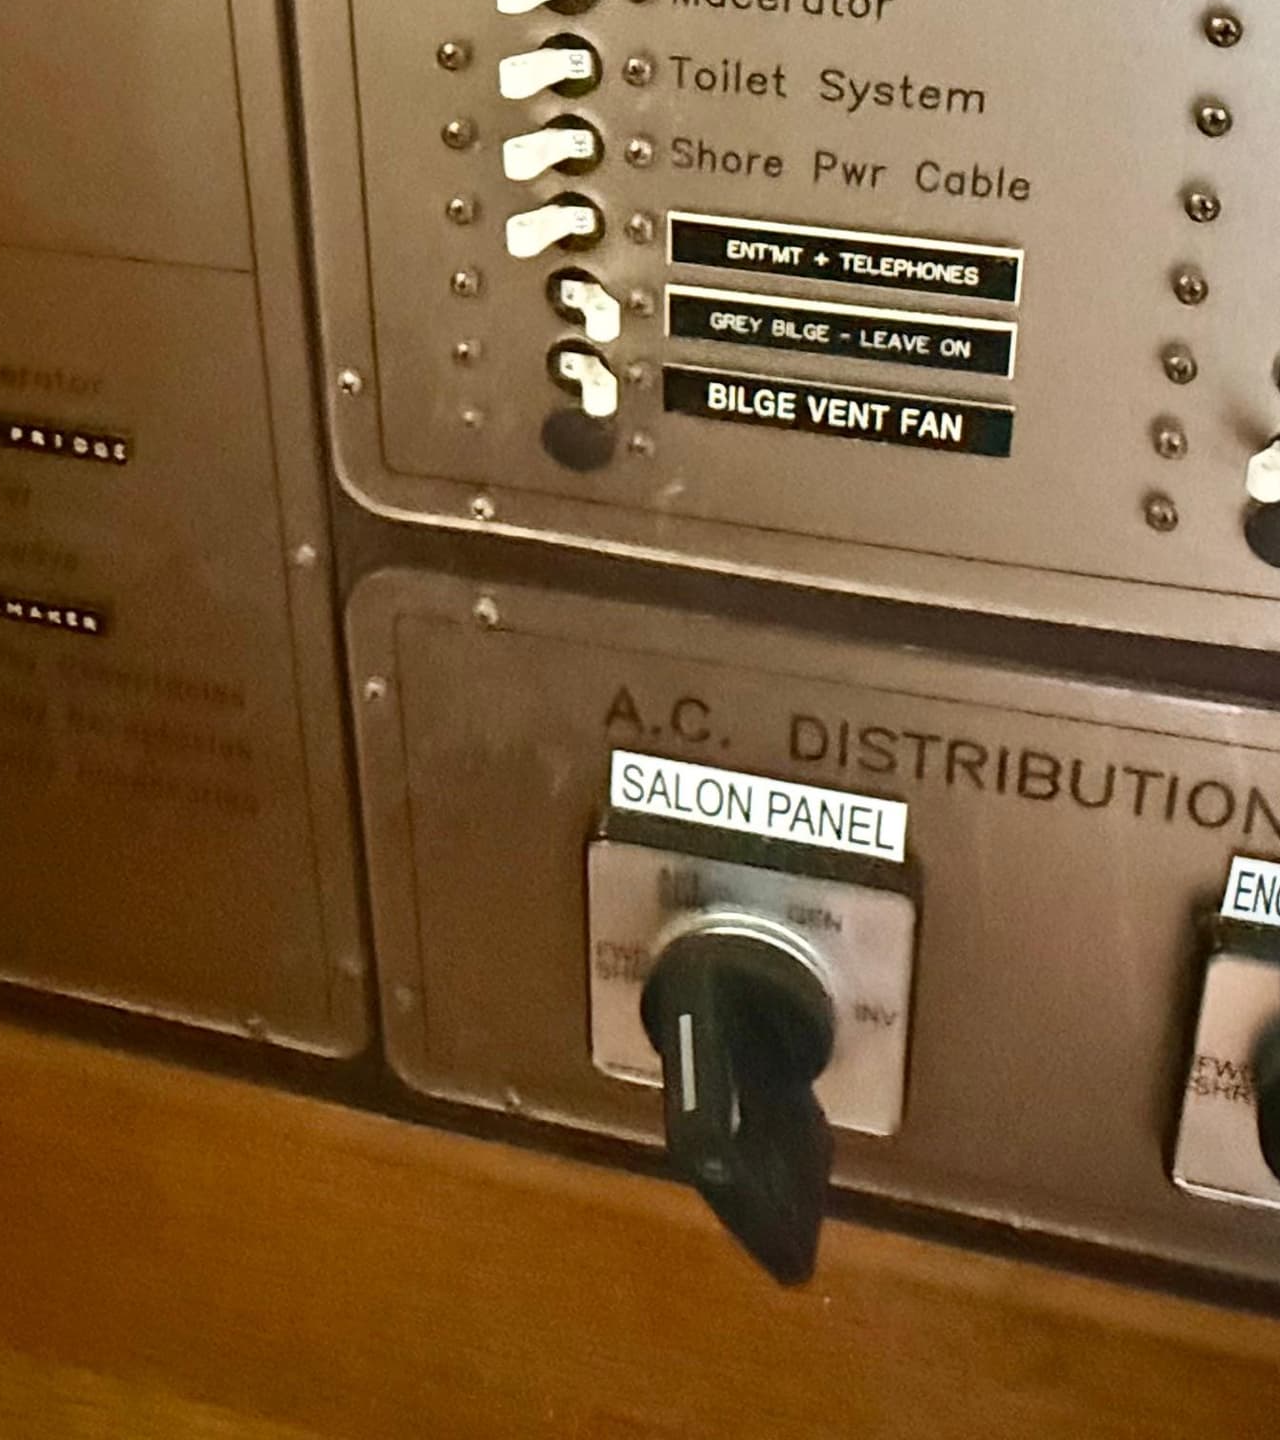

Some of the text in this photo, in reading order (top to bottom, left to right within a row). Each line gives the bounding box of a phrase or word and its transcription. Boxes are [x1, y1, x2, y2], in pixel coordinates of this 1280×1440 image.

[669, 56, 985, 114] Toilet System
[671, 137, 1030, 202] Shore Pwr Cable
[840, 252, 979, 286] TELEPHONES
[710, 312, 762, 333] GREY
[772, 319, 829, 342] BILGE
[860, 330, 930, 354] LEAVE
[940, 339, 971, 358] ON
[707, 384, 962, 441] BILGE VENT FAN
[604, 685, 732, 750] A.C.
[623, 764, 895, 851] SALON PANEL
